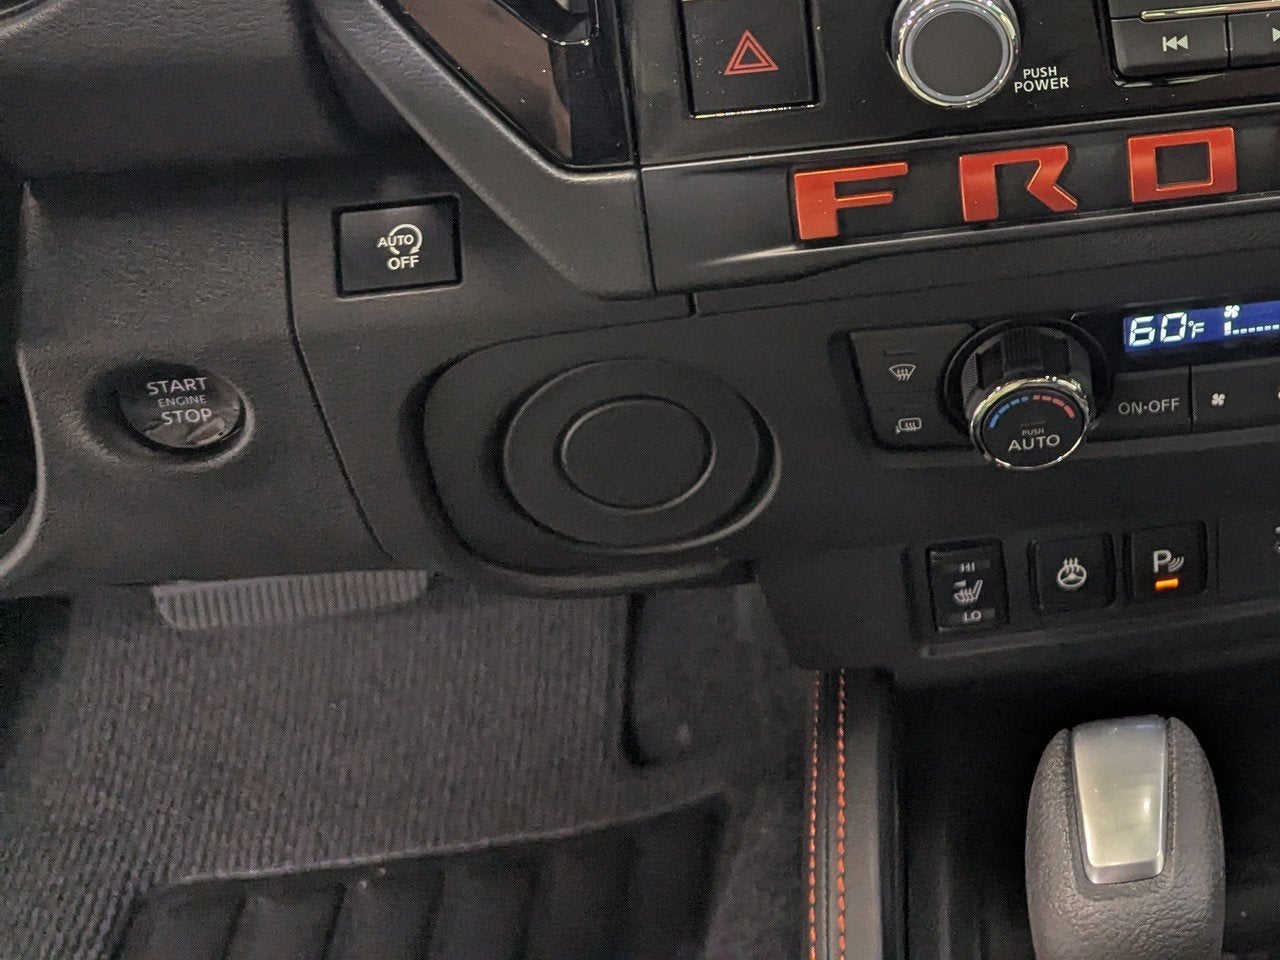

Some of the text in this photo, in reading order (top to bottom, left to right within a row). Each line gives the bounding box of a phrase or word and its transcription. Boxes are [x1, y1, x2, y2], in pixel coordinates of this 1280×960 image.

[1023, 66, 1057, 79] PUSH
[1014, 77, 1069, 93] POWER
[377, 234, 414, 249] AUTO
[387, 256, 420, 271] OFF
[146, 377, 207, 395] START
[157, 394, 207, 407] ENGINE
[161, 409, 212, 426] STOP
[1022, 428, 1045, 436] PUSH
[1008, 434, 1060, 452] AUTO
[960, 562, 975, 573] HI
[963, 611, 981, 623] LO
